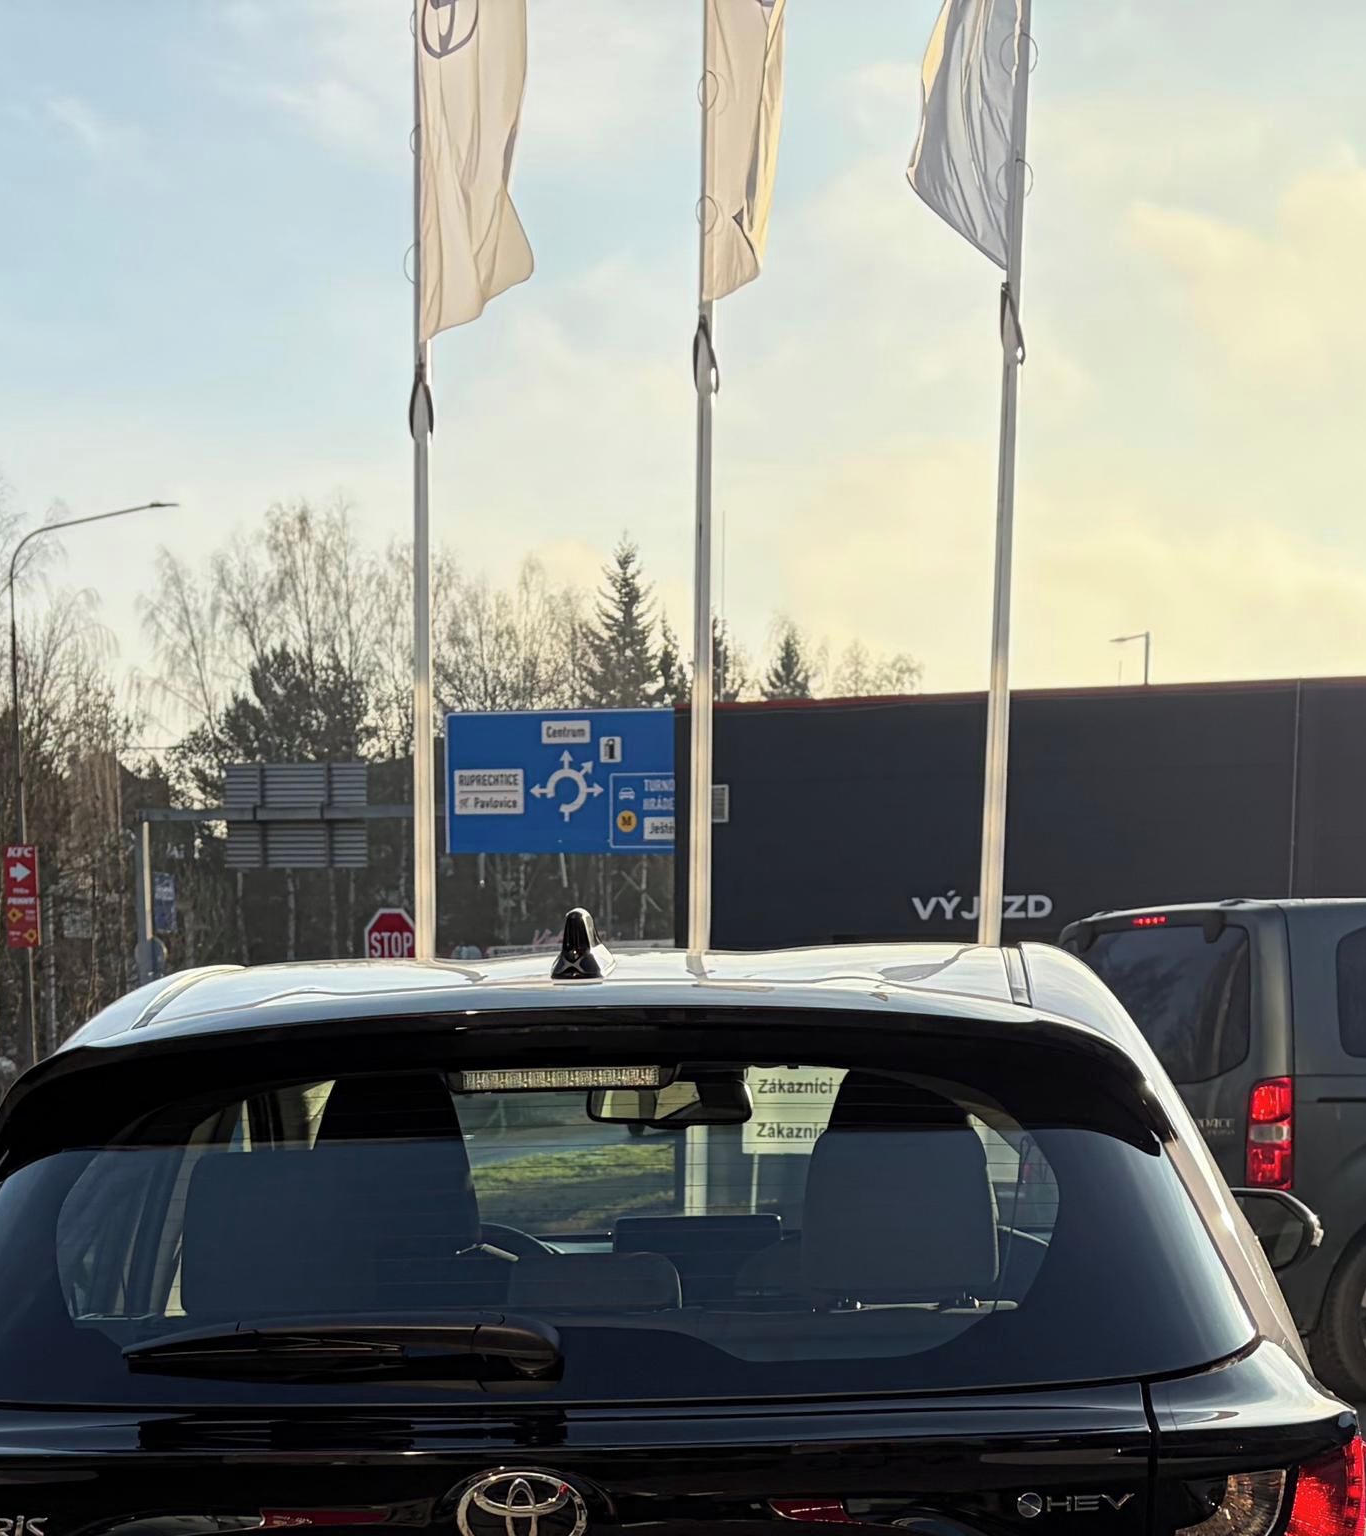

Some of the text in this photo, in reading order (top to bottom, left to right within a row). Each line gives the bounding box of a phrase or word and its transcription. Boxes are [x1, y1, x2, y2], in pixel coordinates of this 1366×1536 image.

[546, 725, 586, 738] Centrum
[474, 797, 517, 809] Pavlovice
[6, 846, 33, 858] KFC
[912, 889, 1053, 921] VÝJZD
[370, 931, 413, 957] STOP
[1046, 1493, 1134, 1514] HEV
